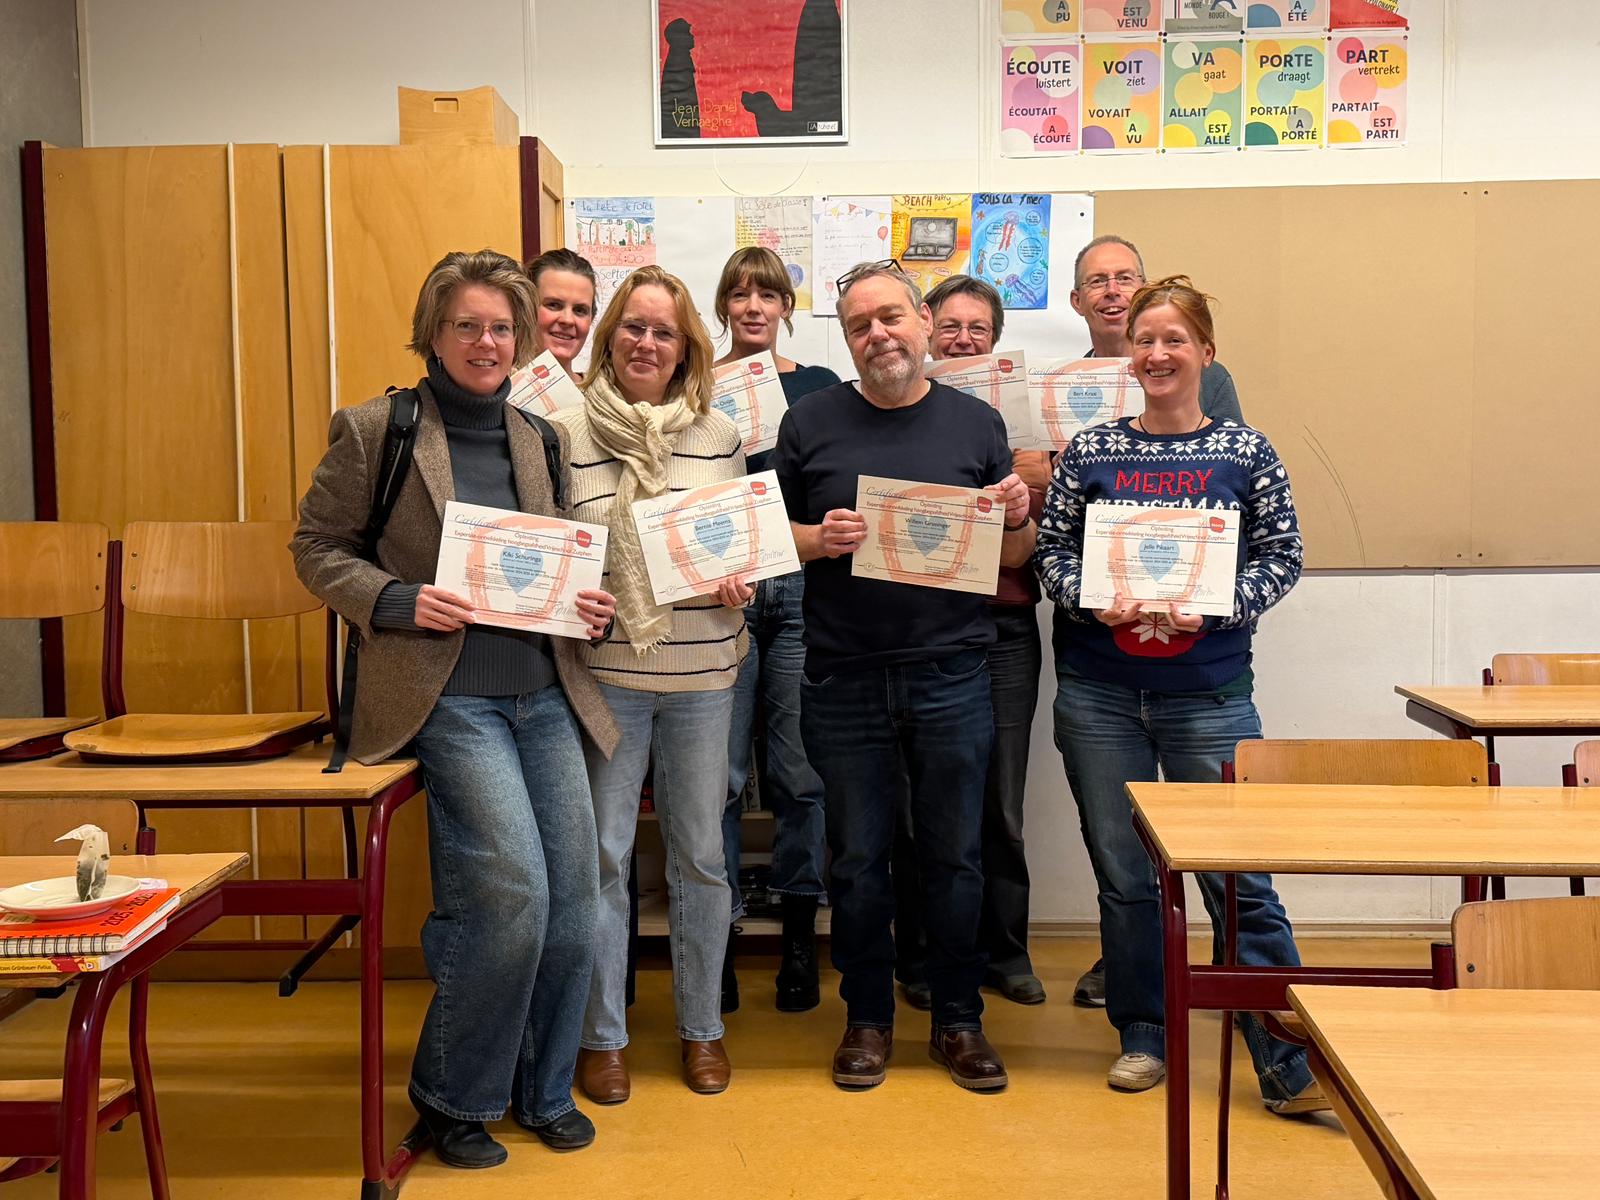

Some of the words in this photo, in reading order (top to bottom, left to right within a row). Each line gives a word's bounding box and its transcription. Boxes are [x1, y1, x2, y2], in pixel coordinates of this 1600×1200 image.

[1056, 12, 1071, 22] PU
[1123, 6, 1143, 17] EST
[1288, 11, 1308, 22] ÉTÉ
[1117, 18, 1148, 28] VENU
[1192, 52, 1215, 66] VA
[1260, 54, 1313, 68] PORTE
[1346, 50, 1389, 63] PART
[1006, 58, 1071, 76] ÉCOUTE
[1103, 60, 1143, 74] VOIT
[1358, 64, 1400, 76] vertrekt
[1126, 76, 1146, 87] ziet
[1204, 70, 1226, 82] gaat
[1278, 71, 1310, 82] draagt
[1036, 78, 1072, 89] luistert
[672, 97, 698, 113] Jean
[1332, 102, 1380, 112] PARTAIT
[1008, 106, 1057, 116] ÉCOUTAIT
[1088, 108, 1131, 118] VOYAIT
[1169, 108, 1208, 118] ALLAIT
[1250, 106, 1298, 116] PORTAIT
[671, 110, 732, 131] Verhaeghe
[1296, 120, 1304, 128] A
[1373, 118, 1392, 128] EST
[1048, 125, 1056, 134] A
[1128, 124, 1137, 132] A
[1208, 124, 1228, 134] EST
[1033, 134, 1072, 144] ÉCOUTÉ
[1126, 134, 1142, 144] VU
[1204, 132, 1230, 144] ALLÉ
[1282, 128, 1318, 140] PORTÉ
[1366, 129, 1399, 139] PARTI
[902, 195, 932, 206] BEACH
[1114, 468, 1214, 496] MERRY
[502, 550, 513, 559] Kiki
